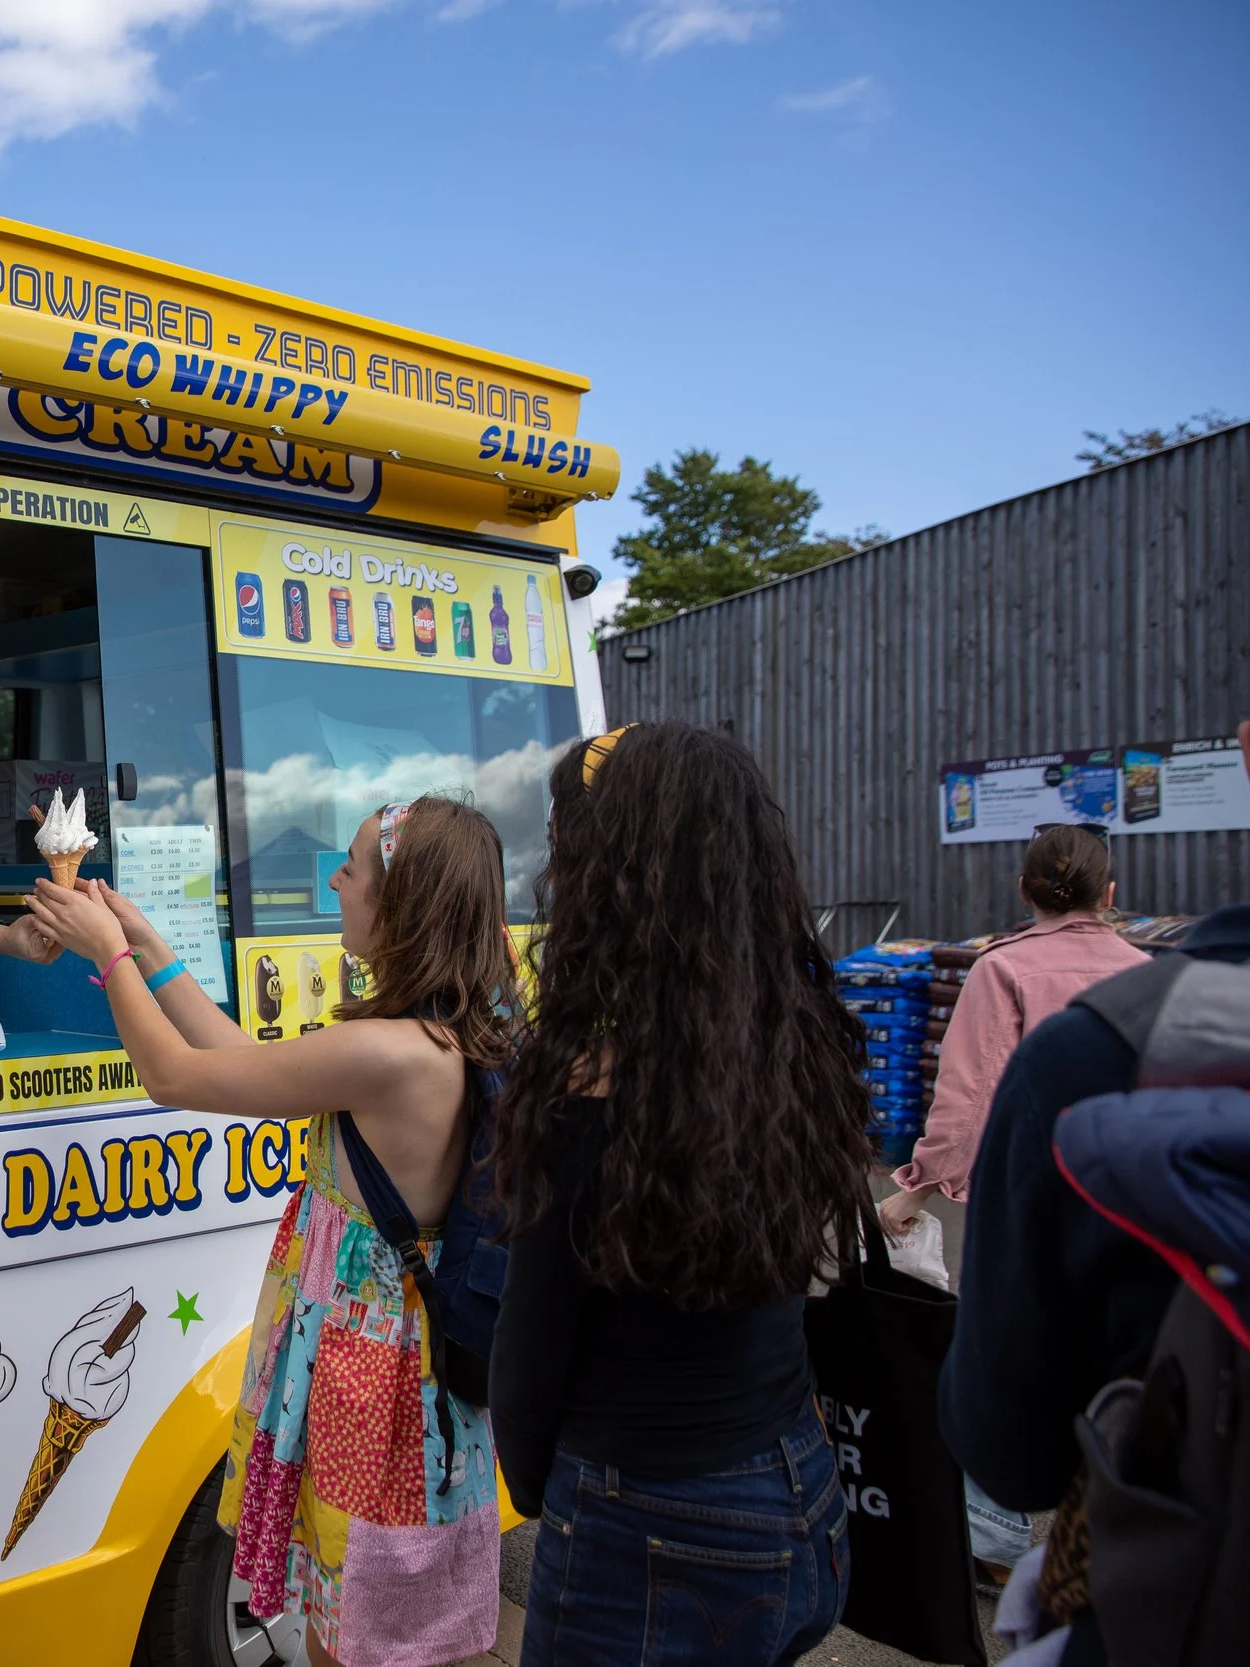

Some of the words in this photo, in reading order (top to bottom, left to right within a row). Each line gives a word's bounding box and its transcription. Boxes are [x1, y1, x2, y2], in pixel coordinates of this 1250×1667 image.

[63, 331, 161, 389] ECO
[171, 354, 349, 426] WHIPPY
[254, 323, 356, 385] ZERO
[367, 353, 551, 431] EMISSIONS
[8, 387, 355, 494] CREAM
[478, 424, 592, 479] SLUSH
[281, 542, 353, 580] Cold
[360, 554, 459, 595] Drinks
[242, 616, 260, 626] pepsi
[413, 615, 435, 631] Tango
[33, 769, 76, 785] wafer
[200, 977, 216, 985] £2.00
[270, 980, 281, 993] M
[312, 976, 323, 988] M
[9, 1064, 93, 1100] SCOOTERS
[1, 1127, 212, 1238] DAIRY
[224, 1116, 313, 1204] ICE
